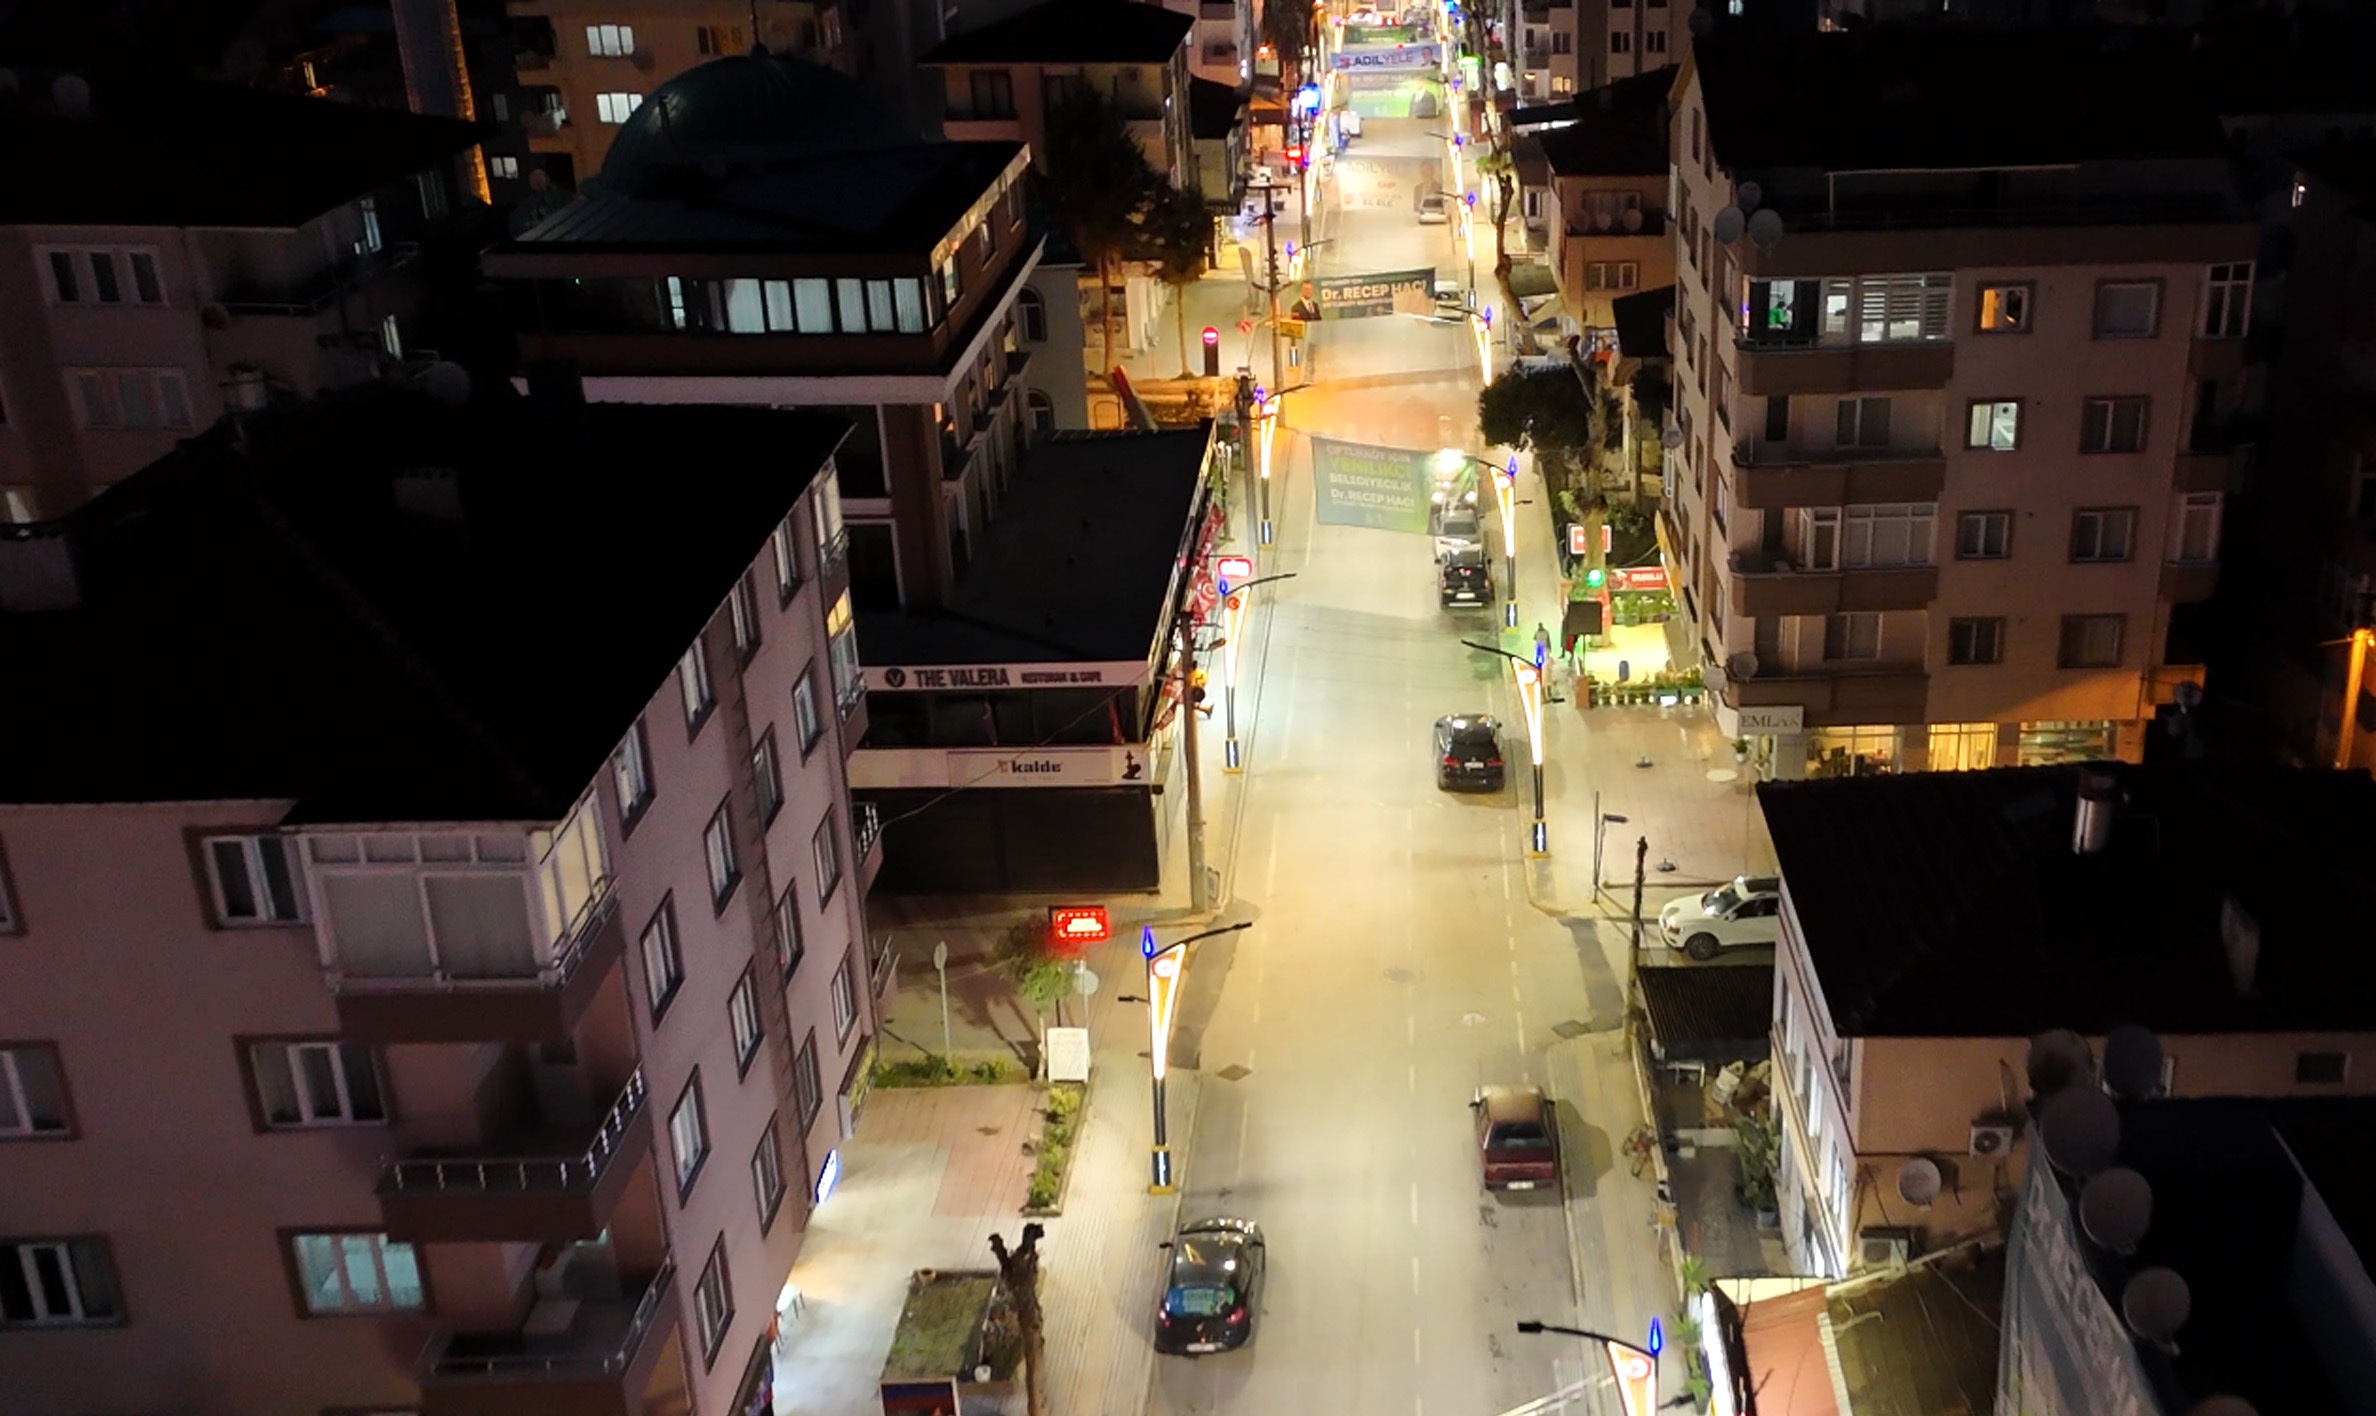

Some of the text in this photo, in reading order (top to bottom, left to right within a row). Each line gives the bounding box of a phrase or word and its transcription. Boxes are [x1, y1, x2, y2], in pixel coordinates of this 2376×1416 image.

[1321, 288, 1341, 301] Dr.
[1343, 284, 1390, 299] RECEP
[914, 669, 946, 688] THE
[949, 667, 1010, 687] VALERA
[1011, 760, 1062, 774] kalde
